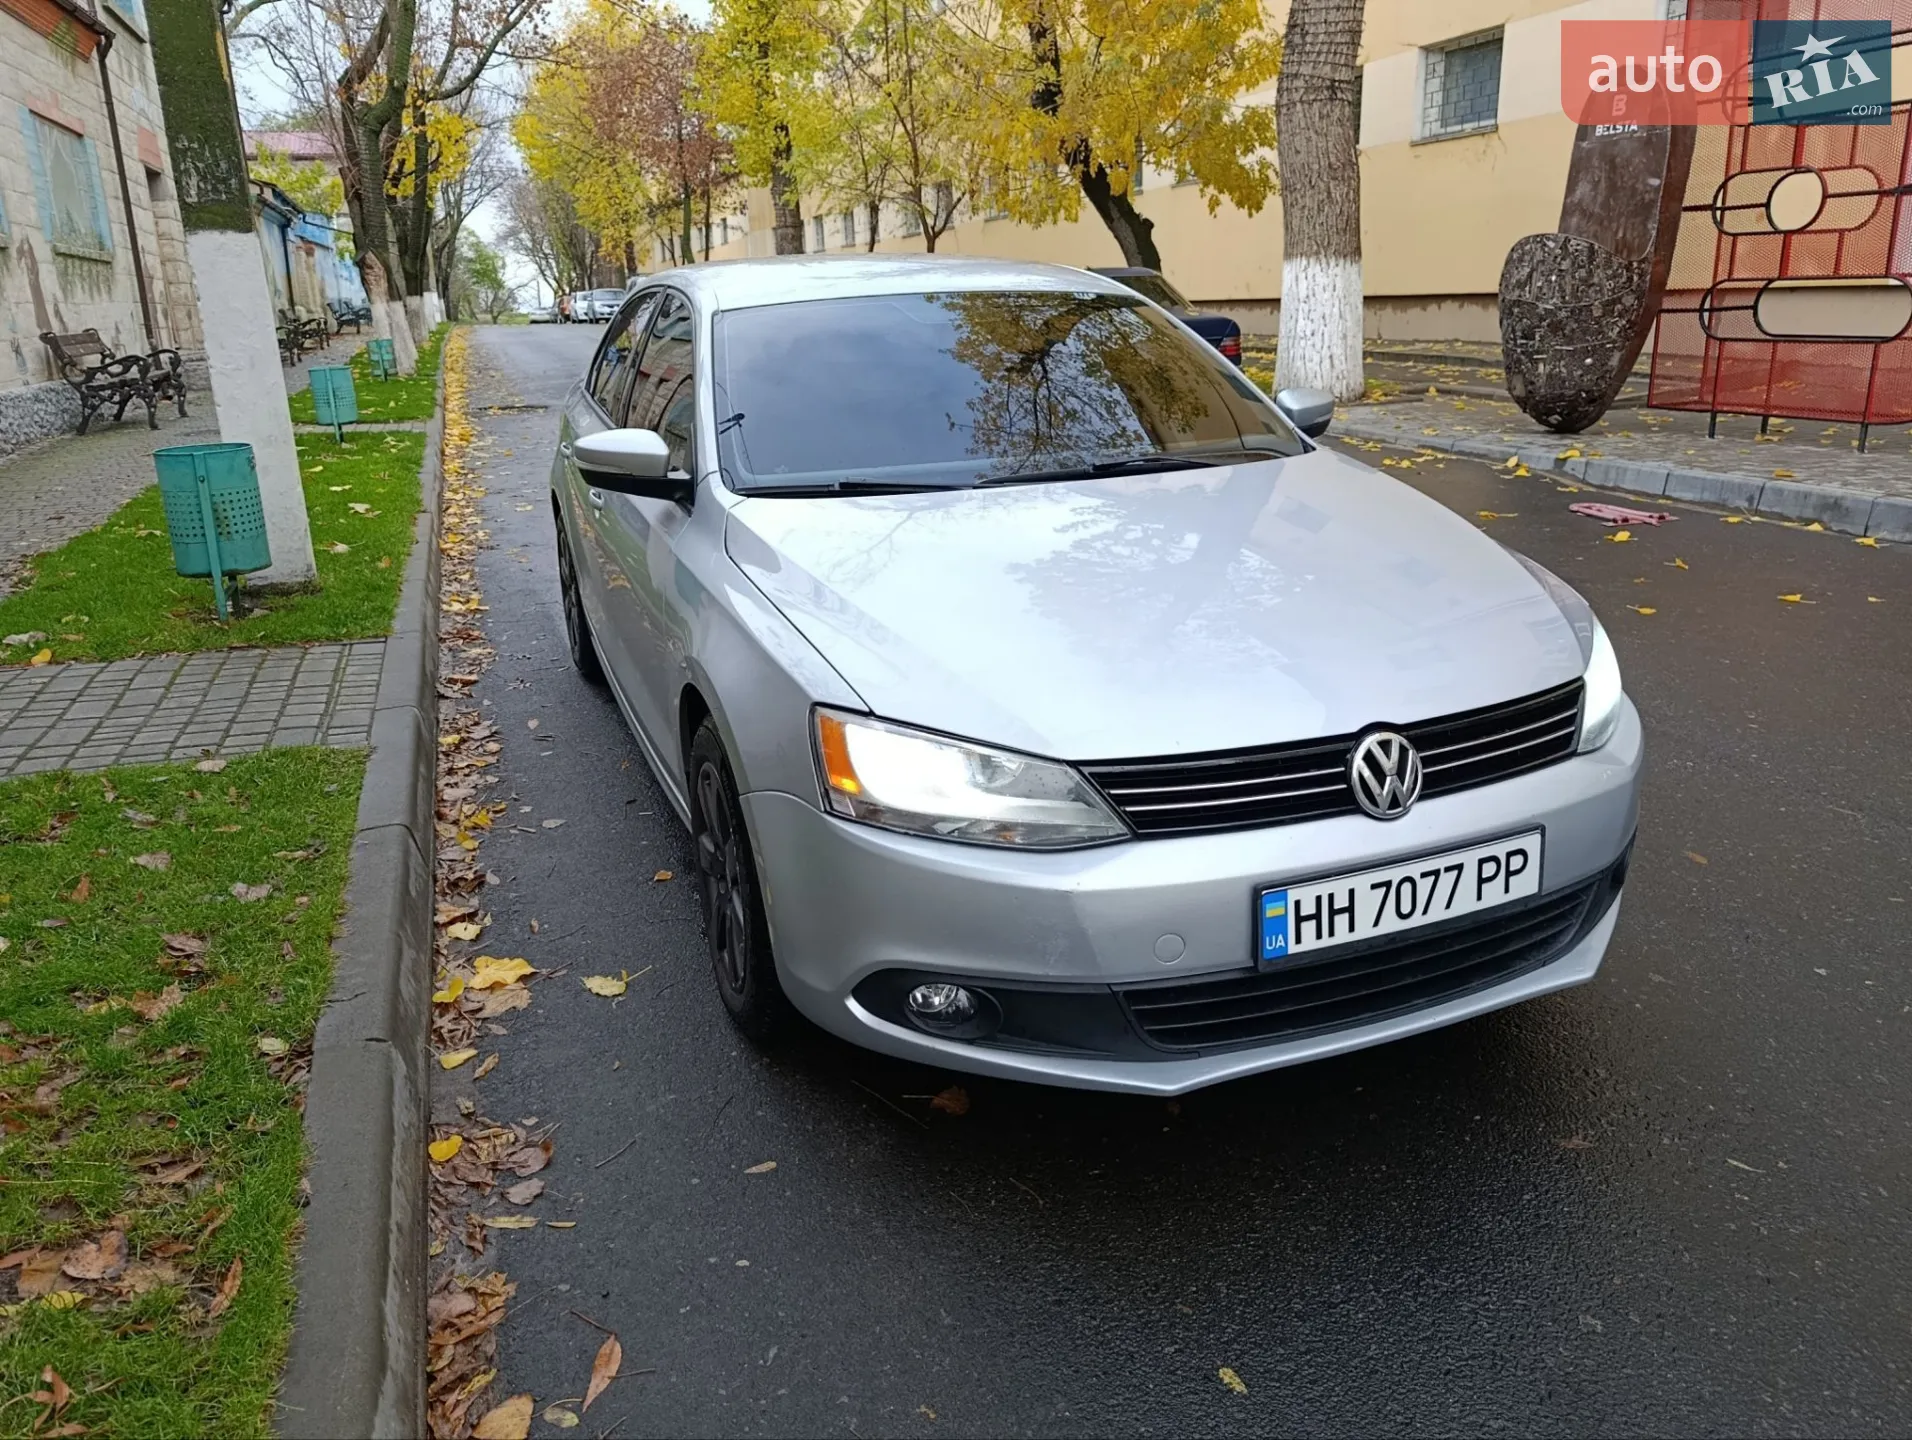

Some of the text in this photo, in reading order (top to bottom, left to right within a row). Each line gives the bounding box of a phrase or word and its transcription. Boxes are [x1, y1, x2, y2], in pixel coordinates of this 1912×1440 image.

[1595, 119, 1638, 137] BELSTA
[1294, 848, 1529, 945] HH 7077 PP
[1265, 934, 1286, 950] UA
